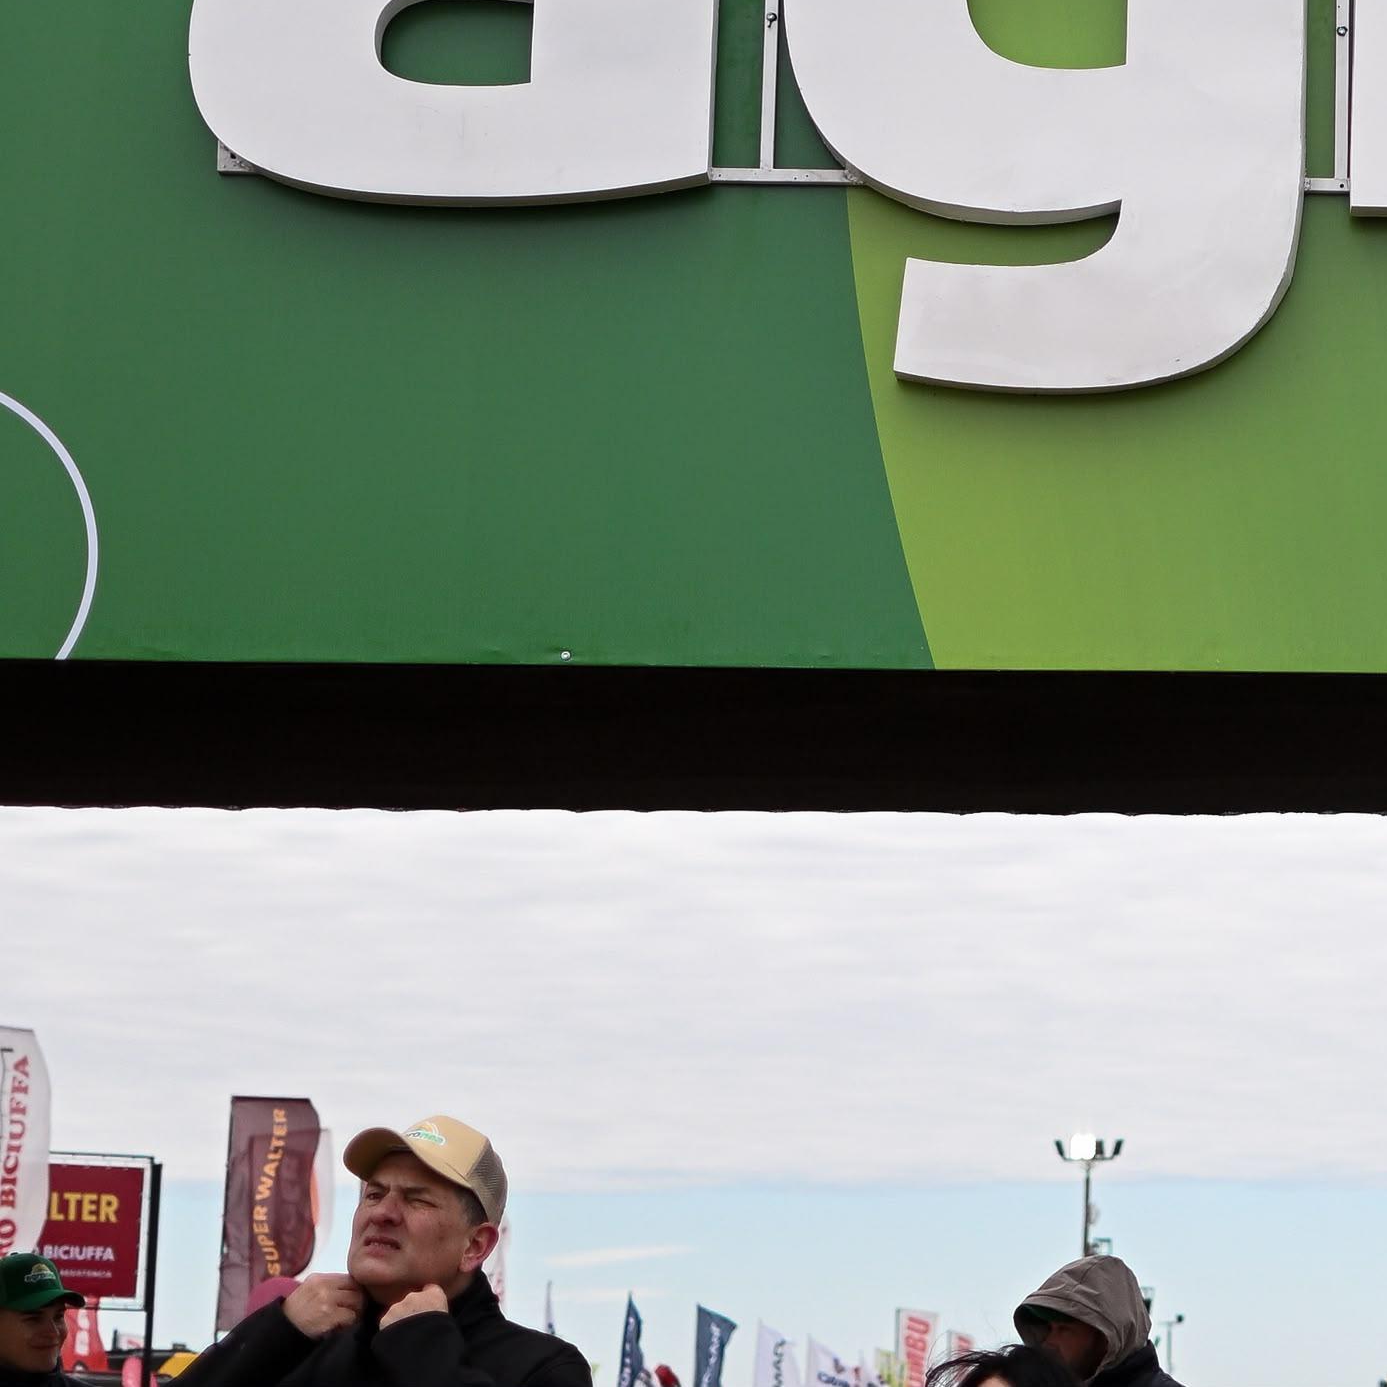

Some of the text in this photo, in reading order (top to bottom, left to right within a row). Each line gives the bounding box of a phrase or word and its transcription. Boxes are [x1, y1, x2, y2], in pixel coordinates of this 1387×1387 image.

[0, 1054, 30, 1209] BICIUFFA
[253, 1108, 288, 1277] SUPER WALTER
